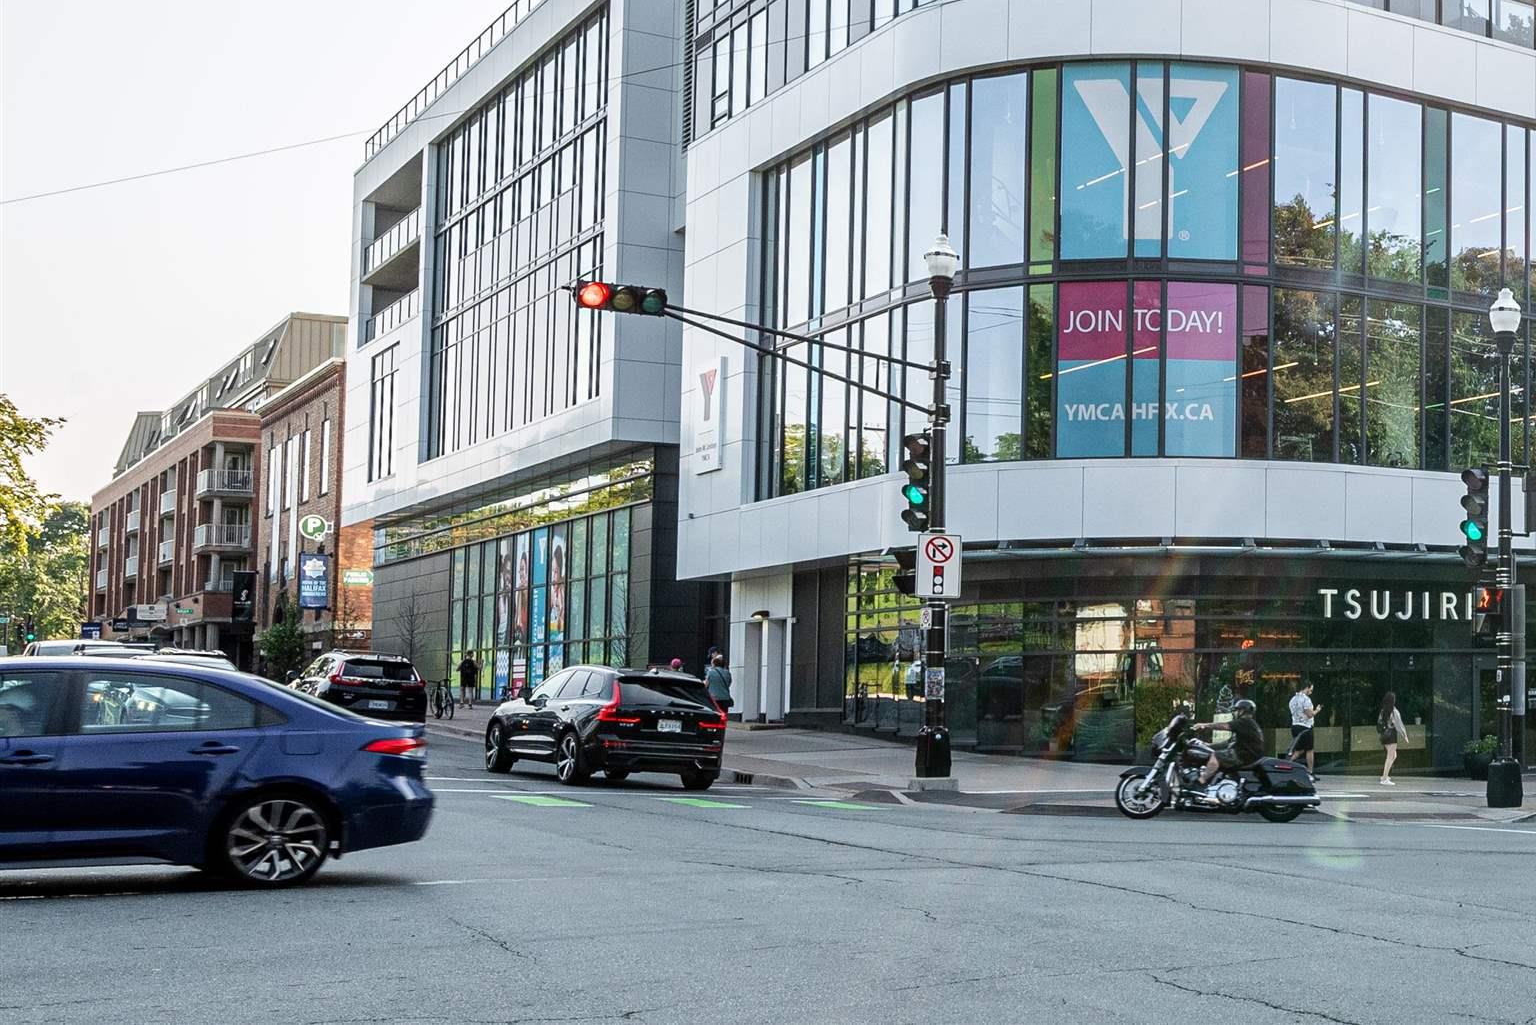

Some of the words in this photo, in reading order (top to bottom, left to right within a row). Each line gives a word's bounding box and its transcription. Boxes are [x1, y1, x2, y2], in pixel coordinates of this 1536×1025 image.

[1063, 309, 1122, 333] JOIN
[1133, 309, 1223, 334] TODAY!
[307, 517, 322, 534] P
